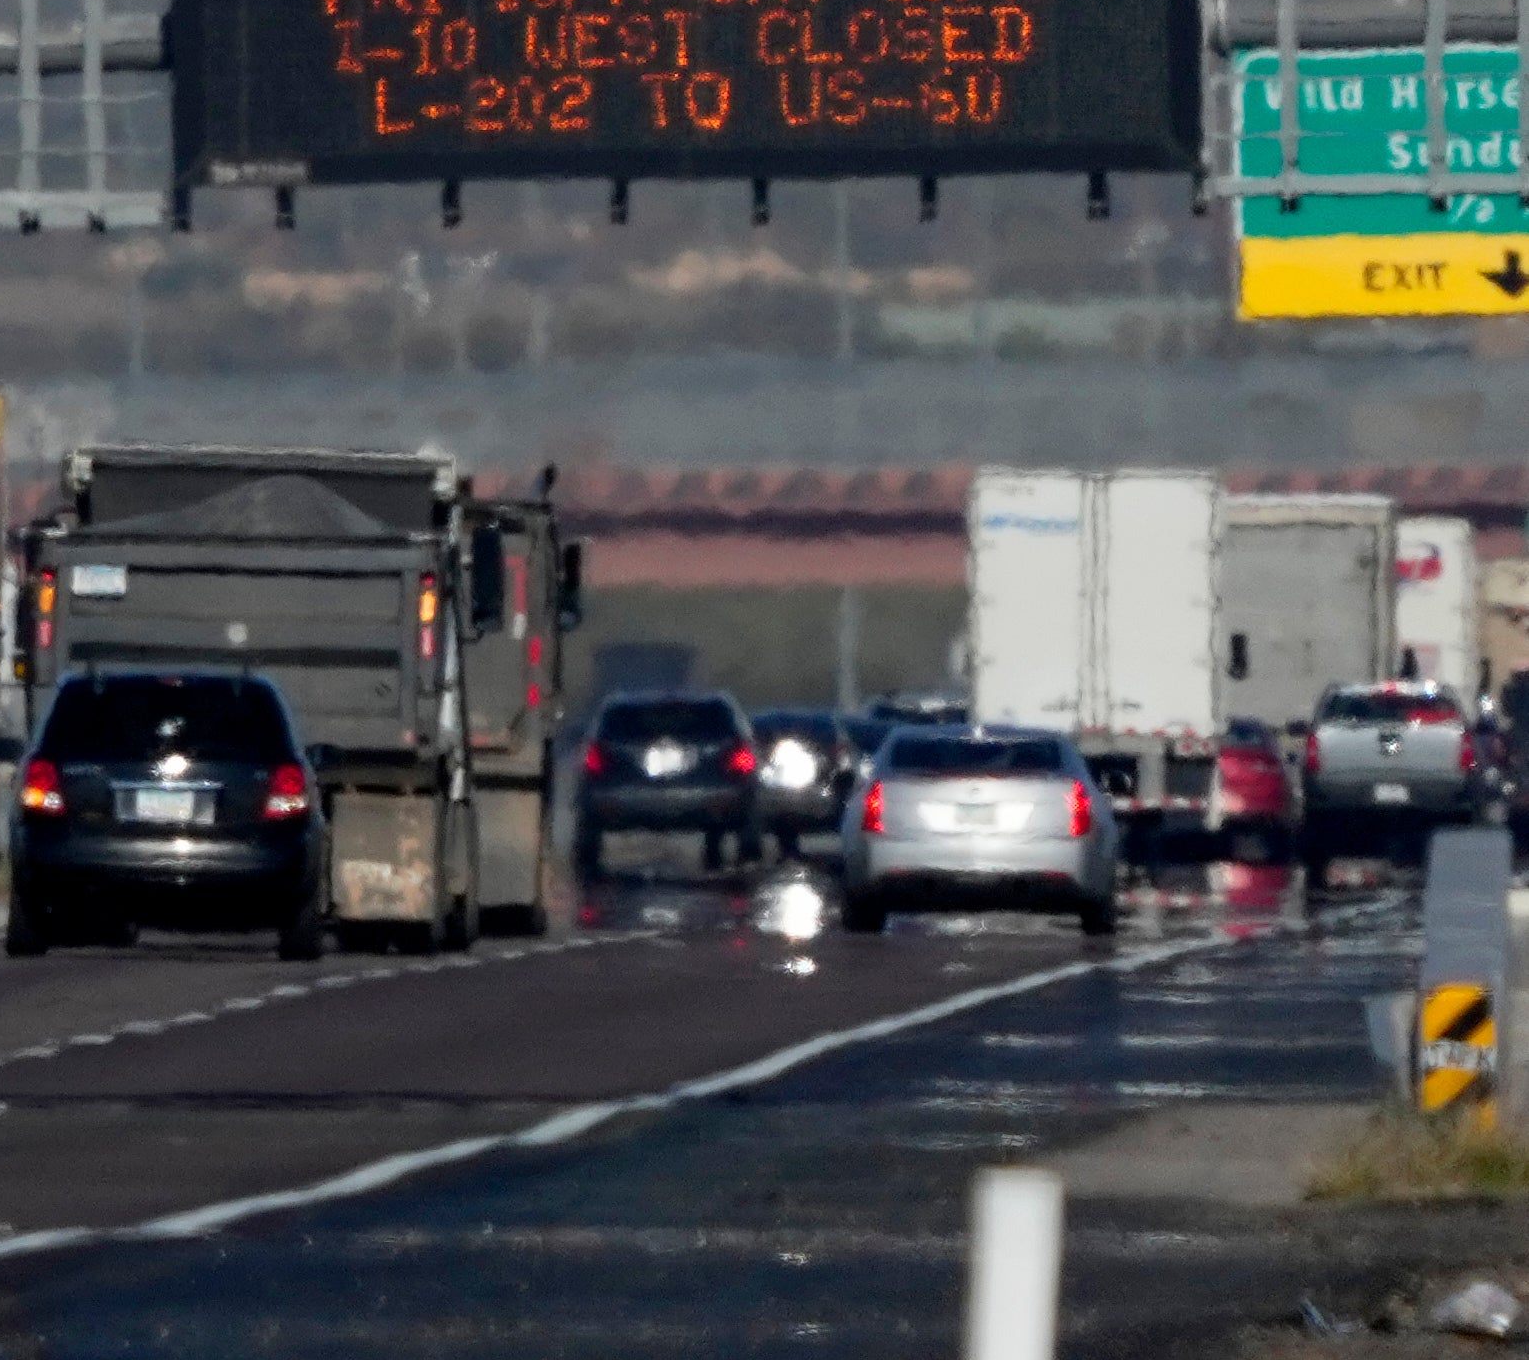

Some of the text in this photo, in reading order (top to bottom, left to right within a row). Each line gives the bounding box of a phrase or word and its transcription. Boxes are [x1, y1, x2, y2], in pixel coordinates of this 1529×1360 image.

[333, 3, 1034, 75] I-10 WEST CLOSED
[374, 74, 594, 135] L-202
[641, 71, 732, 131] TO
[1362, 261, 1448, 292] EXIT
